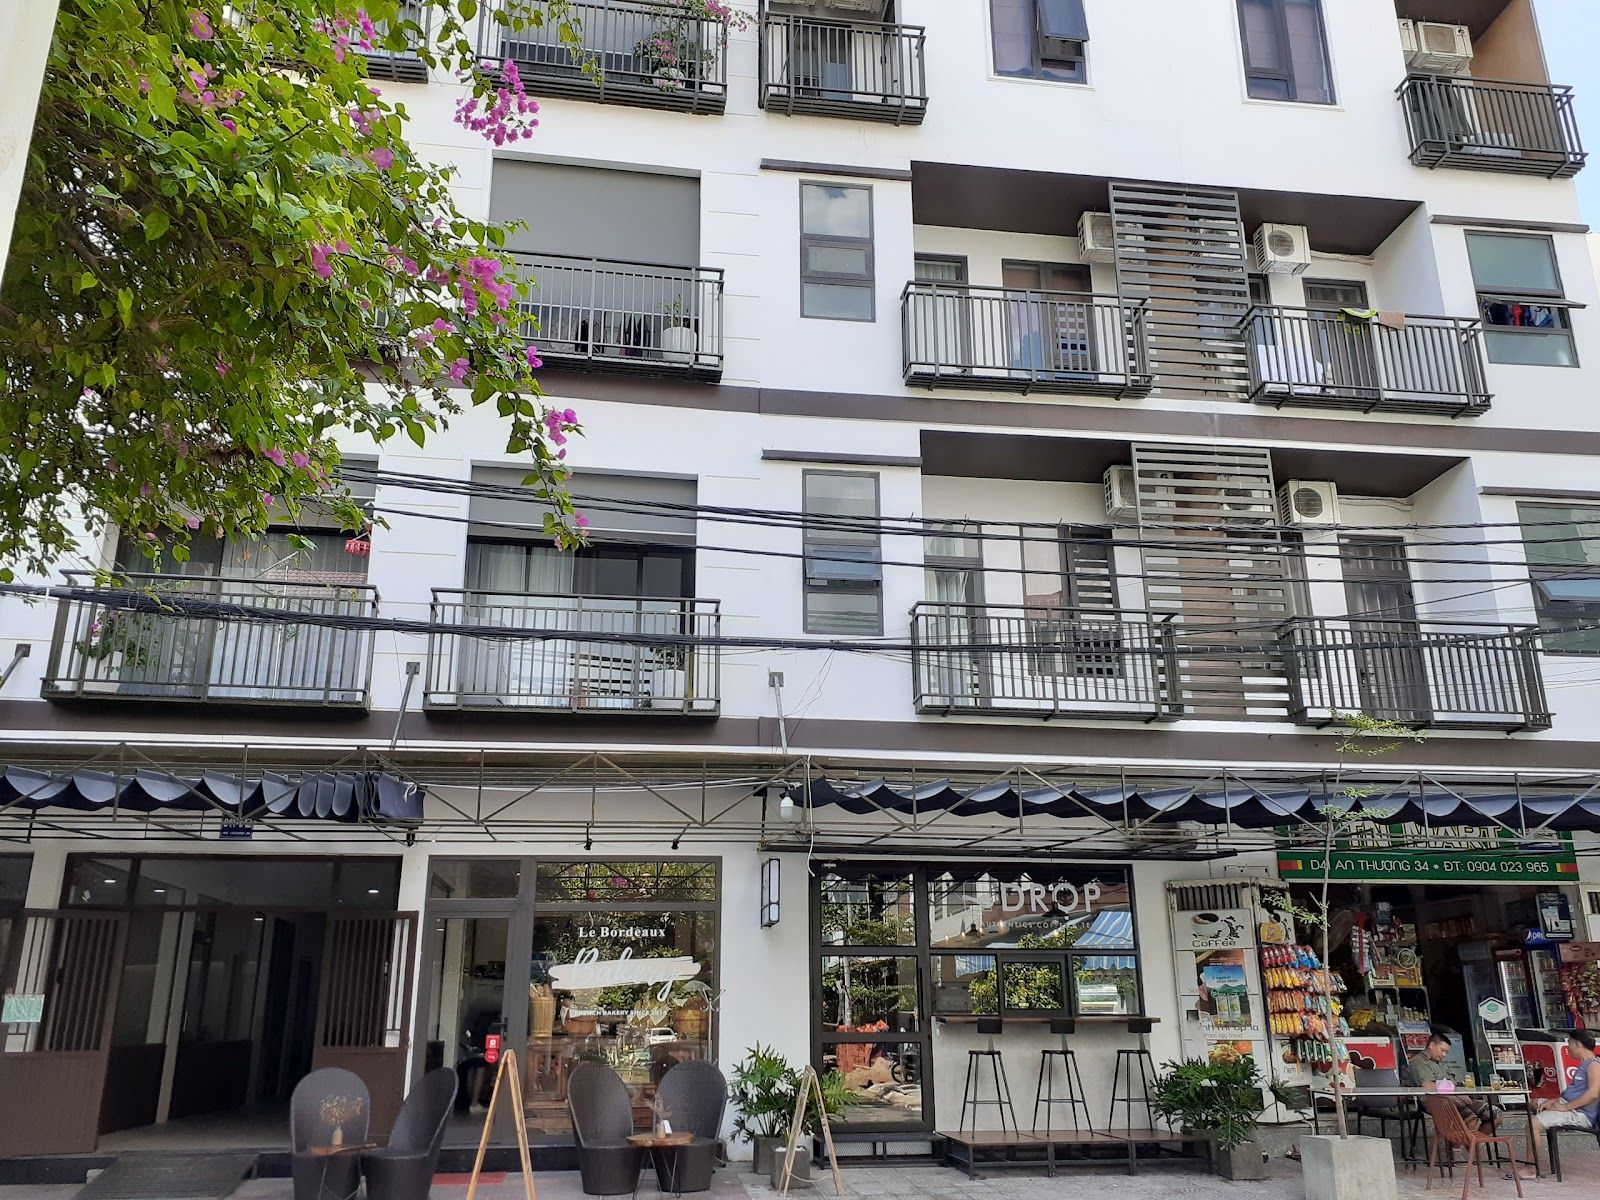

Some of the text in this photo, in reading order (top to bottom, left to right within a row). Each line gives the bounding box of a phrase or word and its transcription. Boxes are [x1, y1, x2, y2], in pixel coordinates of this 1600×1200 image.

[1403, 821, 1501, 849] MART
[1414, 860, 1430, 872] 34
[1467, 861, 1497, 872] 0904
[1500, 862, 1523, 873] 023
[1526, 862, 1549, 873] 965
[1001, 882, 1101, 913] DROP
[578, 926, 666, 938] Le Bordeaux
